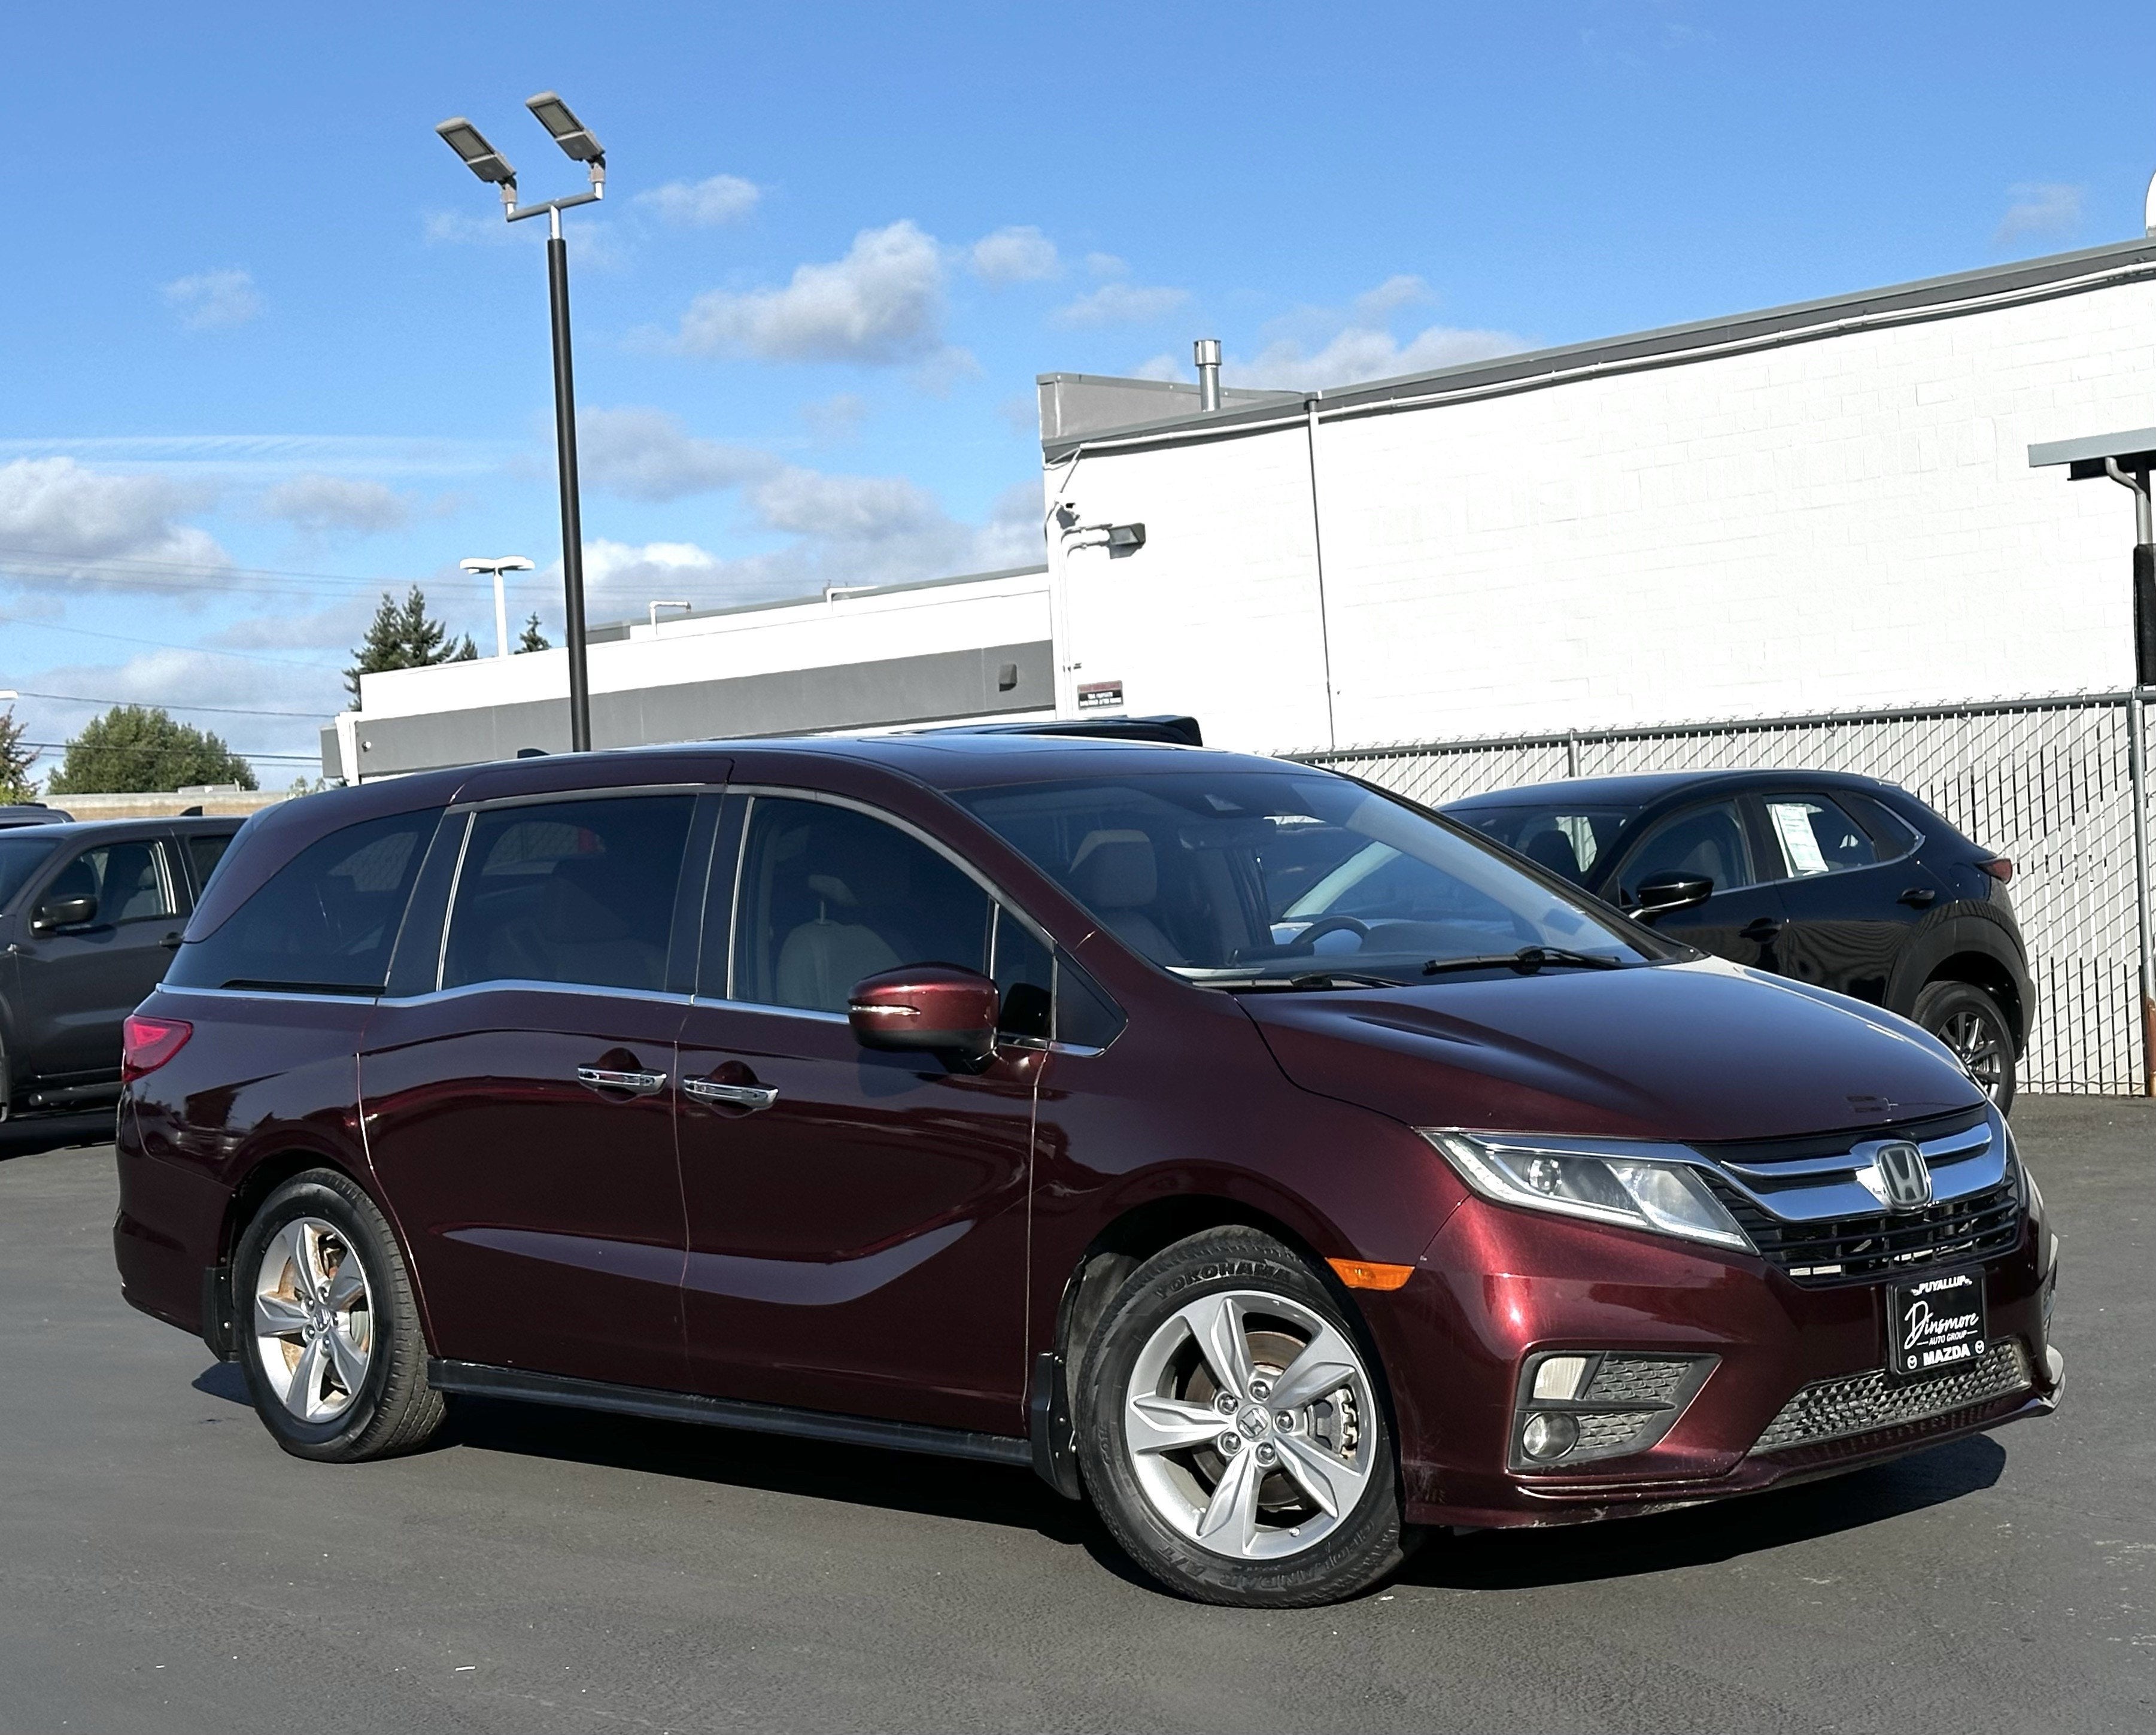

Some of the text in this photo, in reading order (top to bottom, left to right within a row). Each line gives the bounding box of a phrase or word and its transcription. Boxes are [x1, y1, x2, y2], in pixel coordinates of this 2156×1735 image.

[1155, 1261, 1292, 1300] YOKOHAMA
[1919, 1275, 1965, 1294] PUYALLUP
[1903, 1301, 1979, 1350] Dinsmore
[1929, 1329, 1967, 1347] AUTO GROUP
[1923, 1344, 1970, 1366] MAZDA
